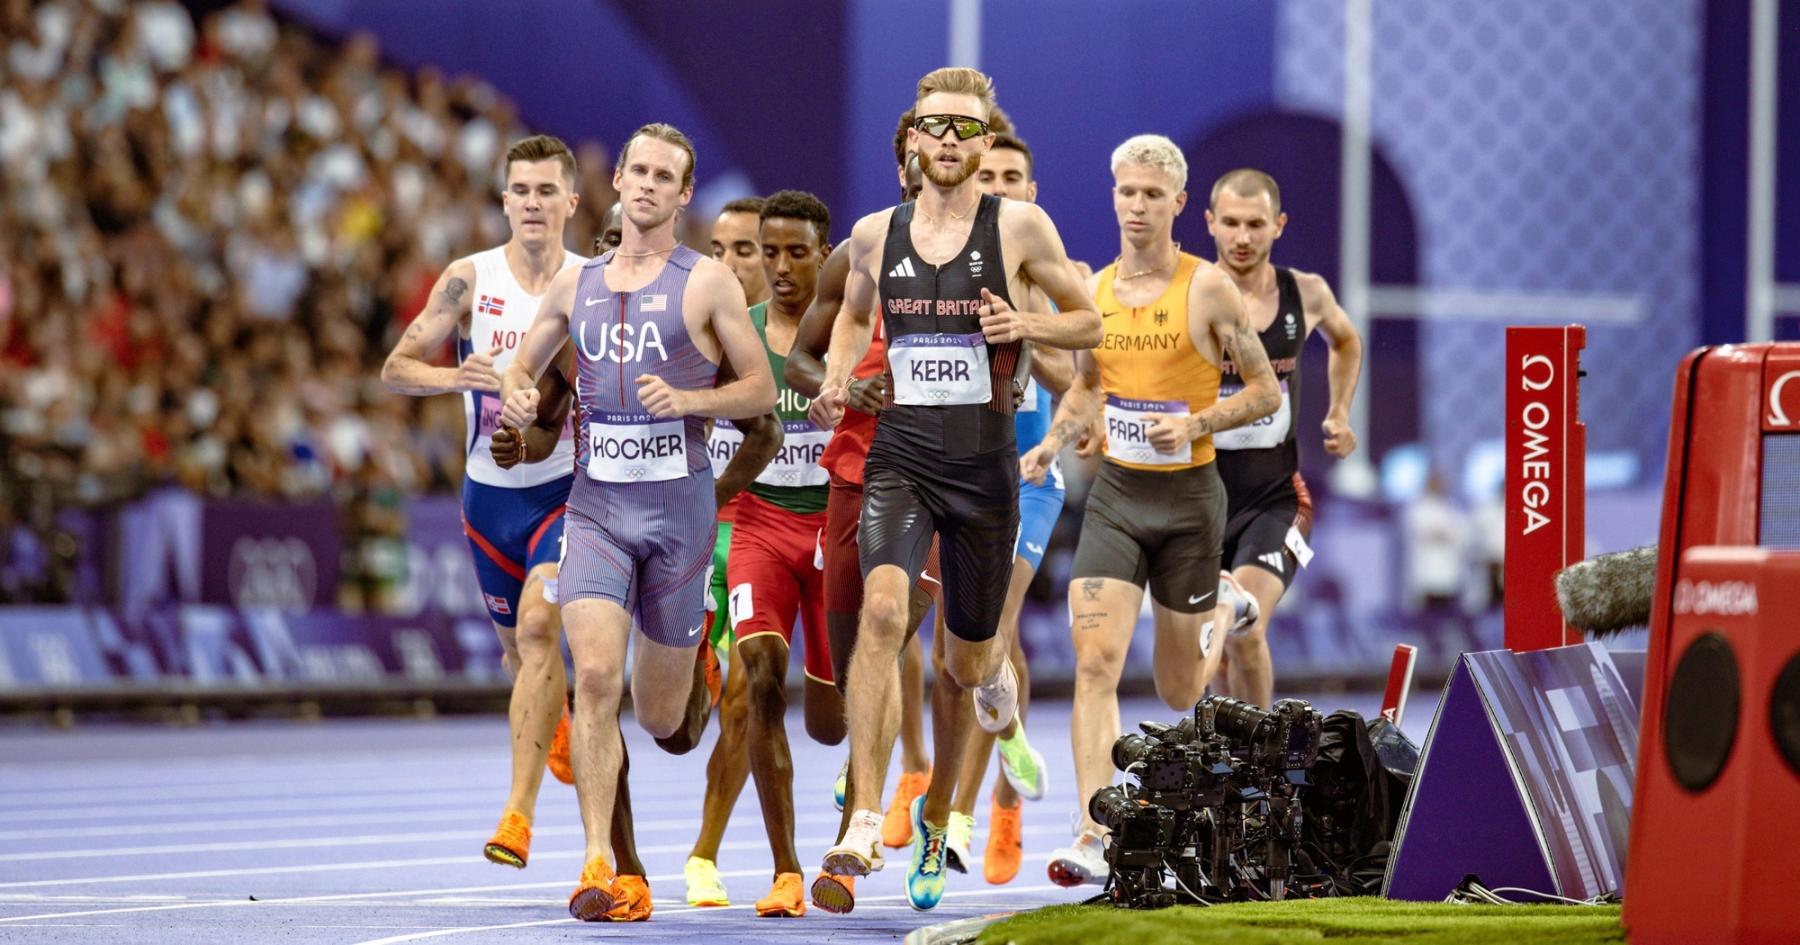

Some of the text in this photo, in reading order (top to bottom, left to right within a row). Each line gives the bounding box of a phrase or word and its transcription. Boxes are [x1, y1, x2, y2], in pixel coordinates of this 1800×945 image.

[887, 298, 932, 316] GREAT
[491, 329, 526, 349] NO
[579, 320, 668, 363] USA
[911, 359, 970, 382] KERR
[593, 434, 684, 460] HOCKER
[1522, 401, 1551, 536] OMEGA
